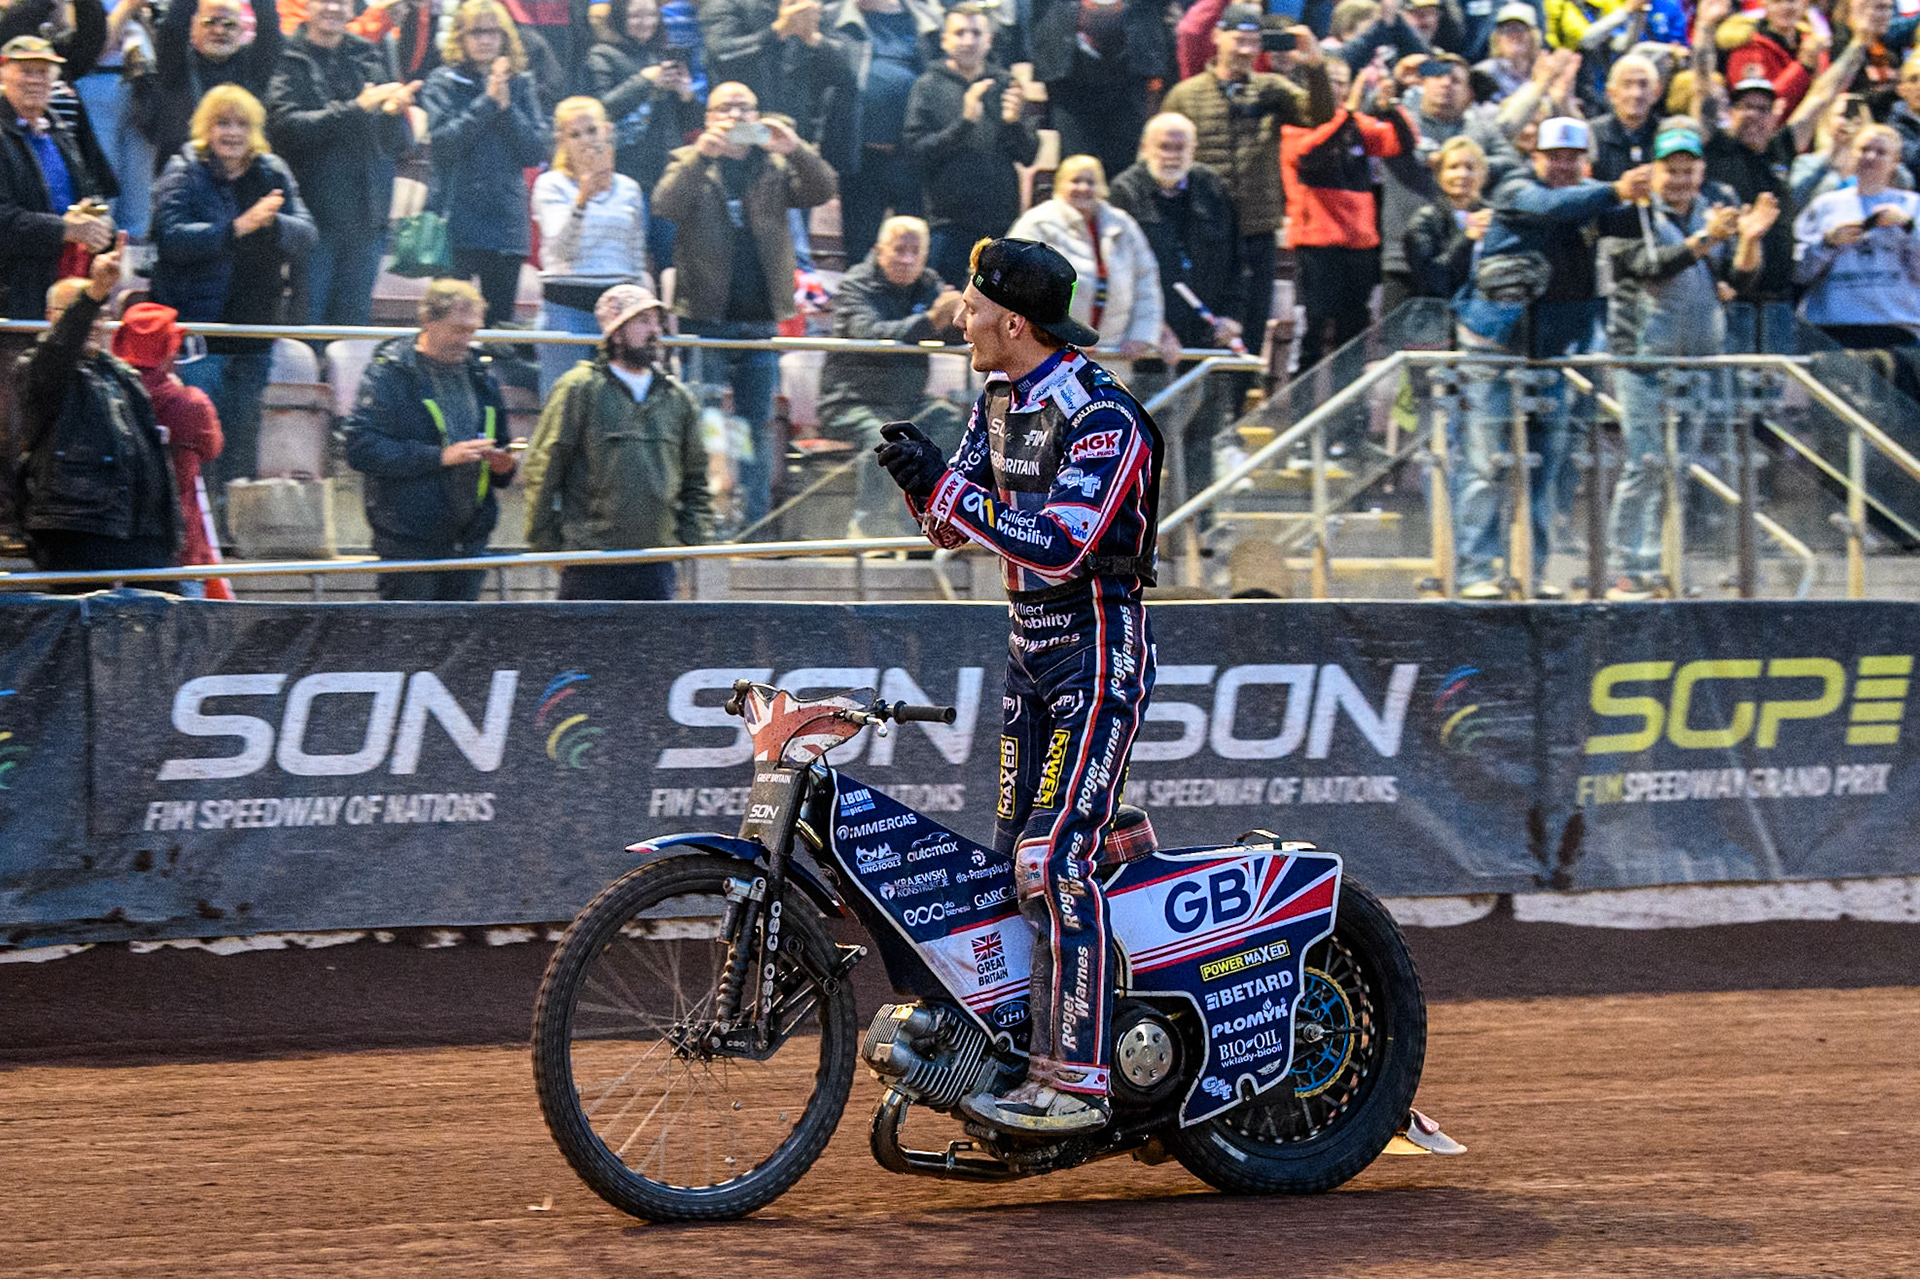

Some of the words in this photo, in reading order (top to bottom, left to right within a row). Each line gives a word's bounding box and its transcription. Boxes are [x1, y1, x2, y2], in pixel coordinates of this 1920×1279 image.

[1072, 431, 1119, 455] NGK
[996, 518, 1053, 549] Mobility
[1000, 509, 1037, 528] Allied
[1119, 605, 1138, 675] Warnes
[1110, 647, 1127, 702] Roger
[156, 670, 520, 780] SON
[1129, 663, 1420, 761] SON
[1042, 733, 1067, 804] POWER
[1097, 717, 1122, 789] Warnes
[1003, 740, 1018, 815] MAXED
[1077, 757, 1100, 817] Roger
[1623, 768, 1747, 801] SPEEDWAY
[1748, 766, 1832, 799] GRAND
[1833, 763, 1892, 795] PRIX
[144, 801, 197, 831] FIM
[200, 797, 345, 829] SPEEDWAY
[345, 795, 384, 825] OF
[384, 793, 496, 824] NATIONS
[749, 804, 779, 819] SON
[906, 842, 959, 862] automax
[1066, 832, 1087, 897] Warnes
[894, 868, 948, 886] KRAJEWSKI
[1164, 867, 1251, 933] GB
[1057, 873, 1081, 930] Roger
[977, 955, 1006, 975] GREAT
[978, 968, 1009, 987] BRITAIN
[1075, 945, 1090, 1019] Warnes
[1203, 957, 1244, 979] POWER
[1244, 944, 1288, 967] MAXED
[1218, 970, 1294, 1007] BETARD
[1000, 1009, 1025, 1025] JHI
[1062, 991, 1077, 1051] Roger
